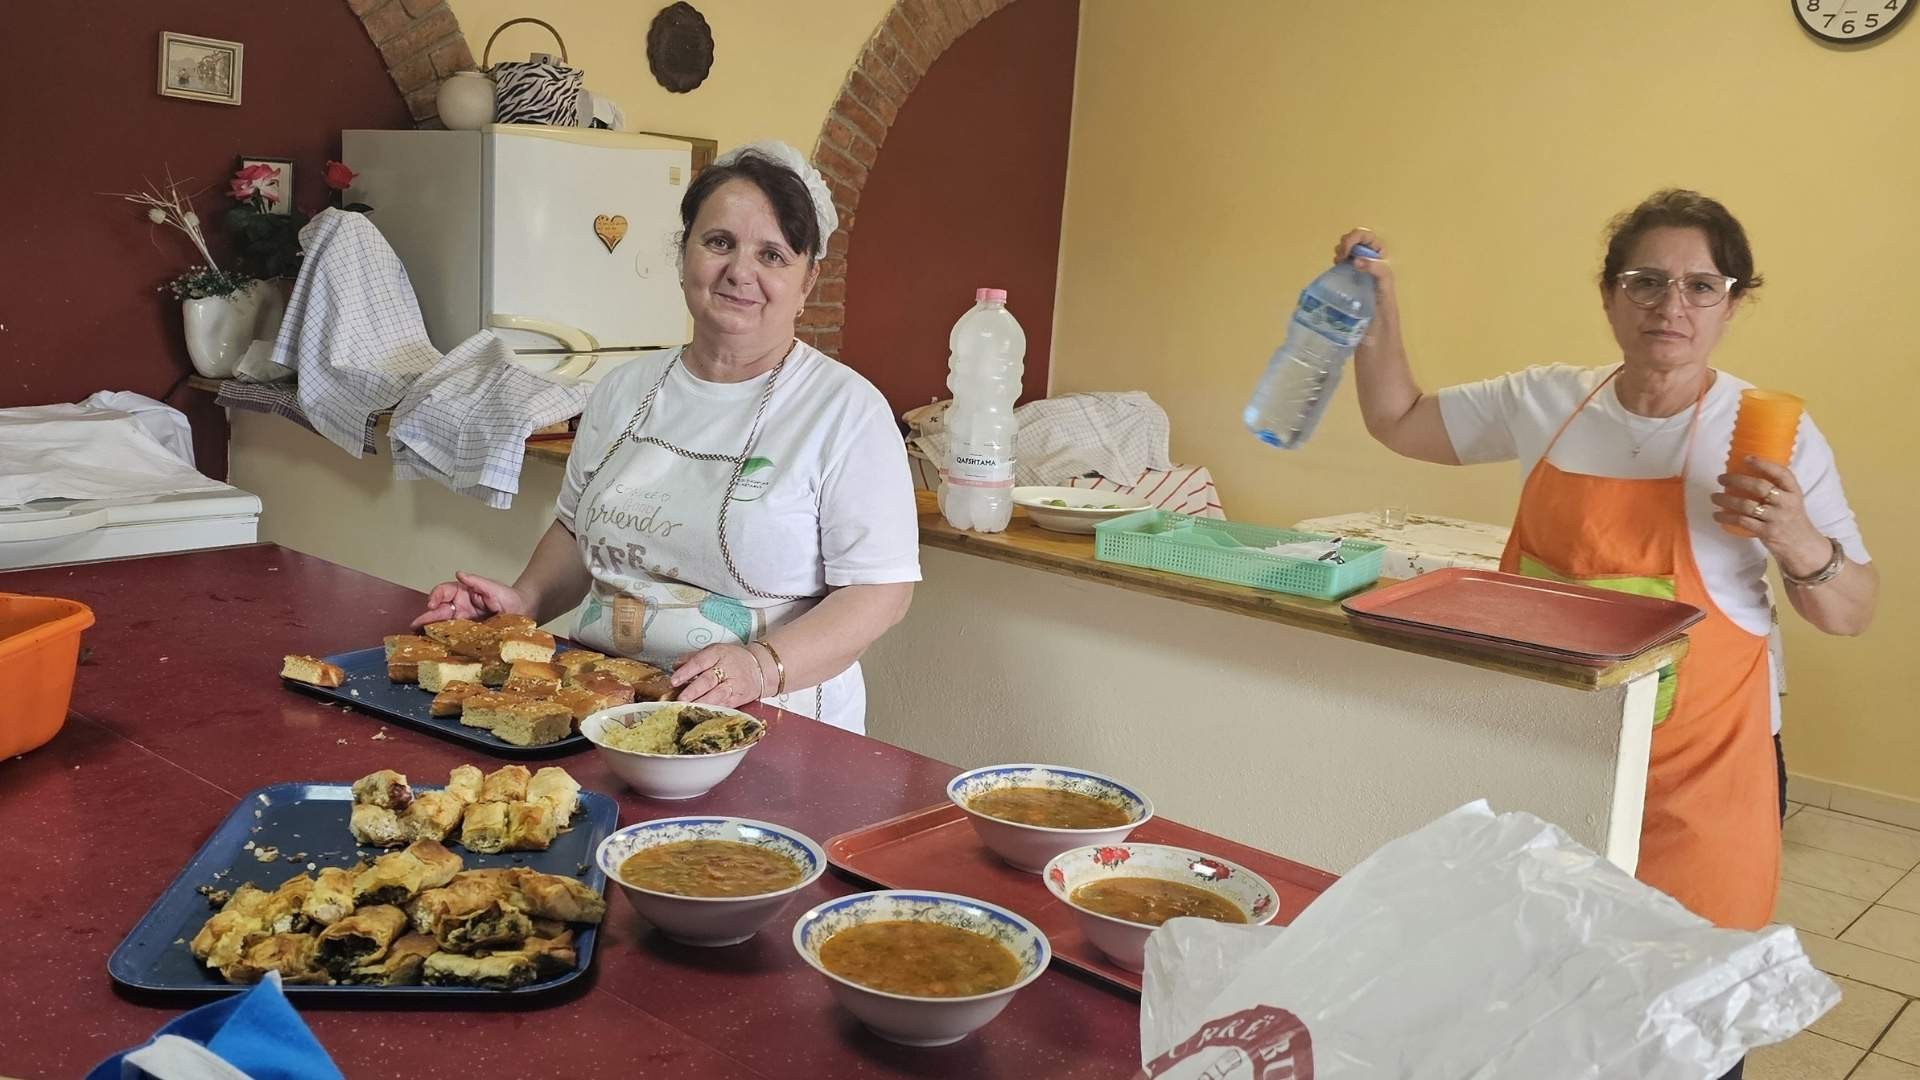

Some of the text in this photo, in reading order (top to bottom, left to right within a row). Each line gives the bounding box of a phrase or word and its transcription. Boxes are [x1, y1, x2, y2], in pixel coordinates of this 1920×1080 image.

[1806, 0, 1820, 12] 8
[1883, 0, 1898, 11] 4
[1823, 13, 1837, 28] 7
[1841, 19, 1856, 34] 6
[1864, 13, 1880, 28] 5
[956, 456, 997, 467] QAFSHTAMA
[584, 491, 683, 538] friends
